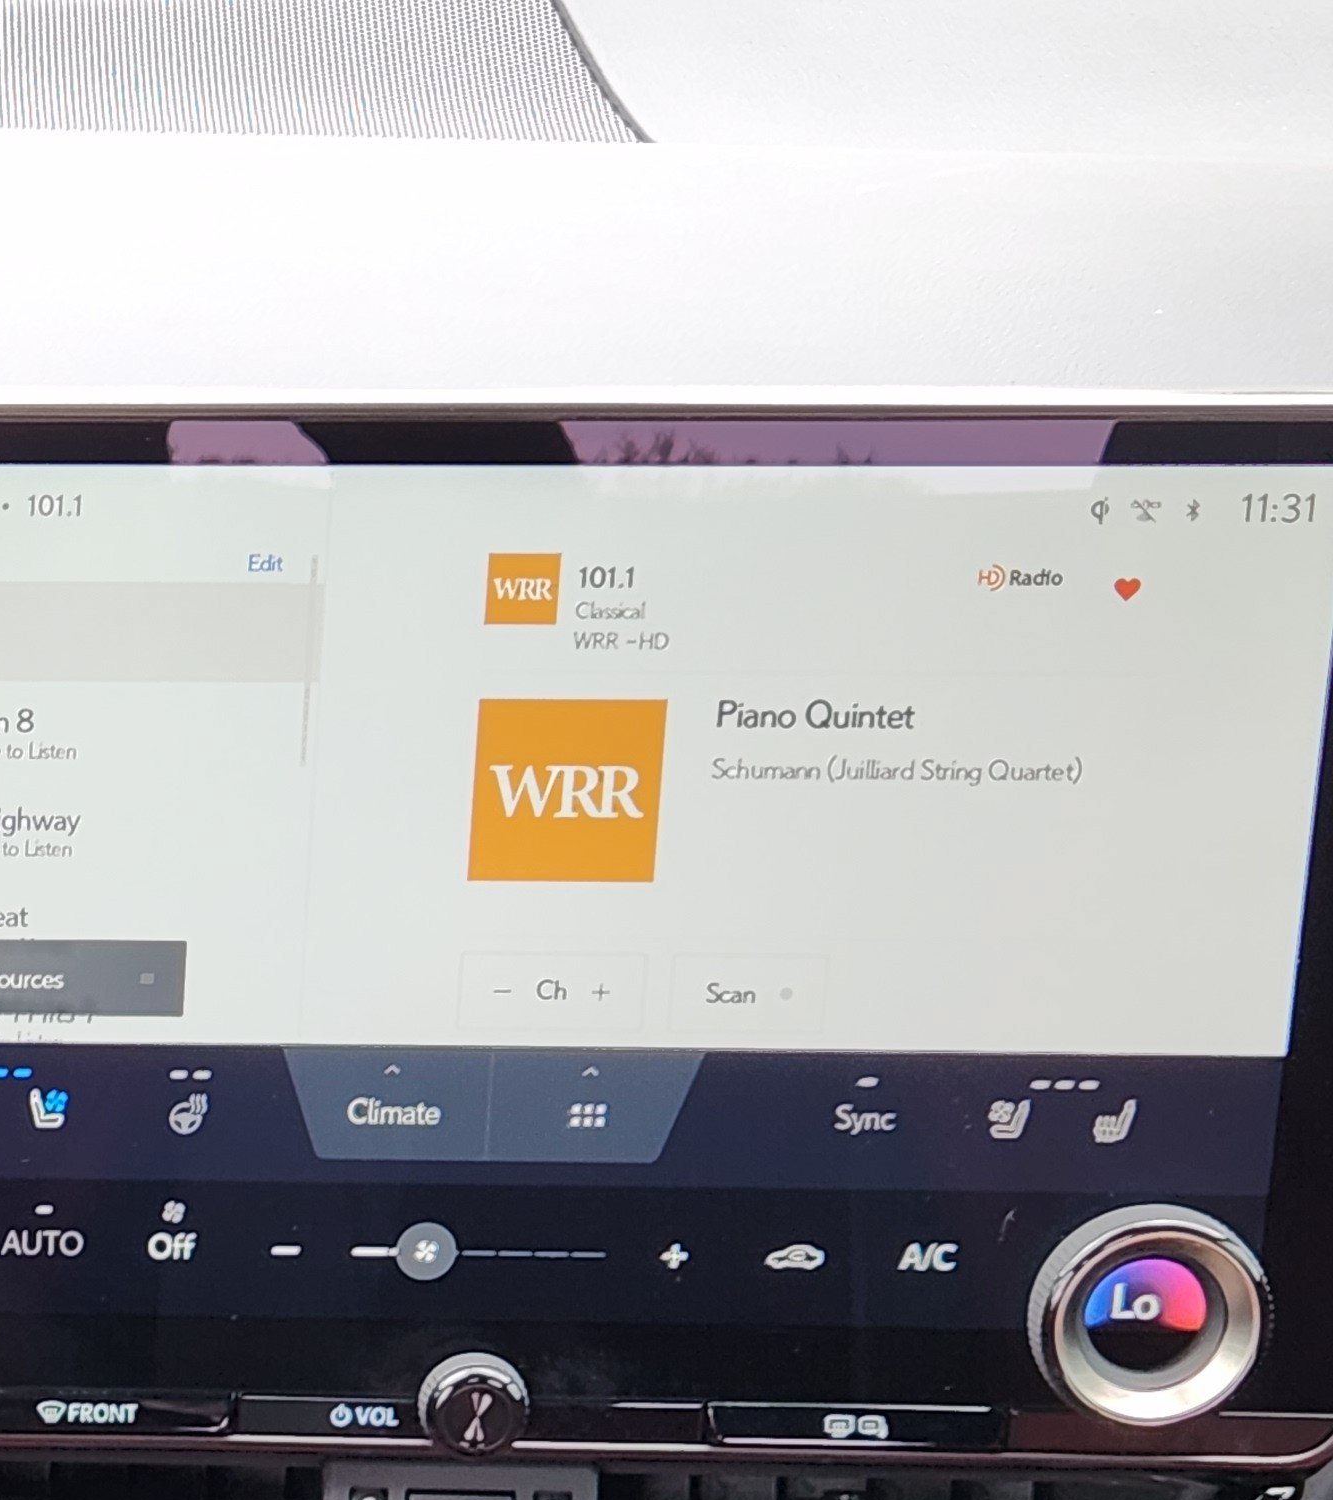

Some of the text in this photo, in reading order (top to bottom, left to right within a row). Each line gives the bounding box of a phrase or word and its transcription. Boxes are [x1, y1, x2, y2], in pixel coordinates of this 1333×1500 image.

[28, 493, 84, 518] 101.1
[1241, 492, 1317, 524] 11:31
[247, 553, 284, 572] Edit
[493, 576, 553, 600] WRR
[579, 566, 635, 588] 101.1
[1009, 567, 1063, 587] Radio
[575, 601, 646, 620] Classical
[573, 631, 619, 650] WRR
[17, 707, 35, 733] 8
[716, 699, 916, 731] Piano Quintet
[6, 743, 24, 760] to
[28, 742, 77, 760] Listen
[711, 755, 1084, 787] Schumann (Juilliard String Quartet)
[489, 764, 644, 819] WRR
[2, 841, 20, 858] to
[25, 840, 73, 858] Listen
[536, 978, 567, 1002] Ch
[706, 983, 756, 1005] Scan
[347, 1097, 441, 1127] Climate
[834, 1103, 896, 1135] Sync
[1, 1230, 85, 1257] AUTO
[147, 1231, 198, 1262] Off
[897, 1241, 958, 1272] A/C
[1110, 1283, 1161, 1321] Lo
[67, 1403, 139, 1424] FRONT
[355, 1406, 400, 1429] VOL
